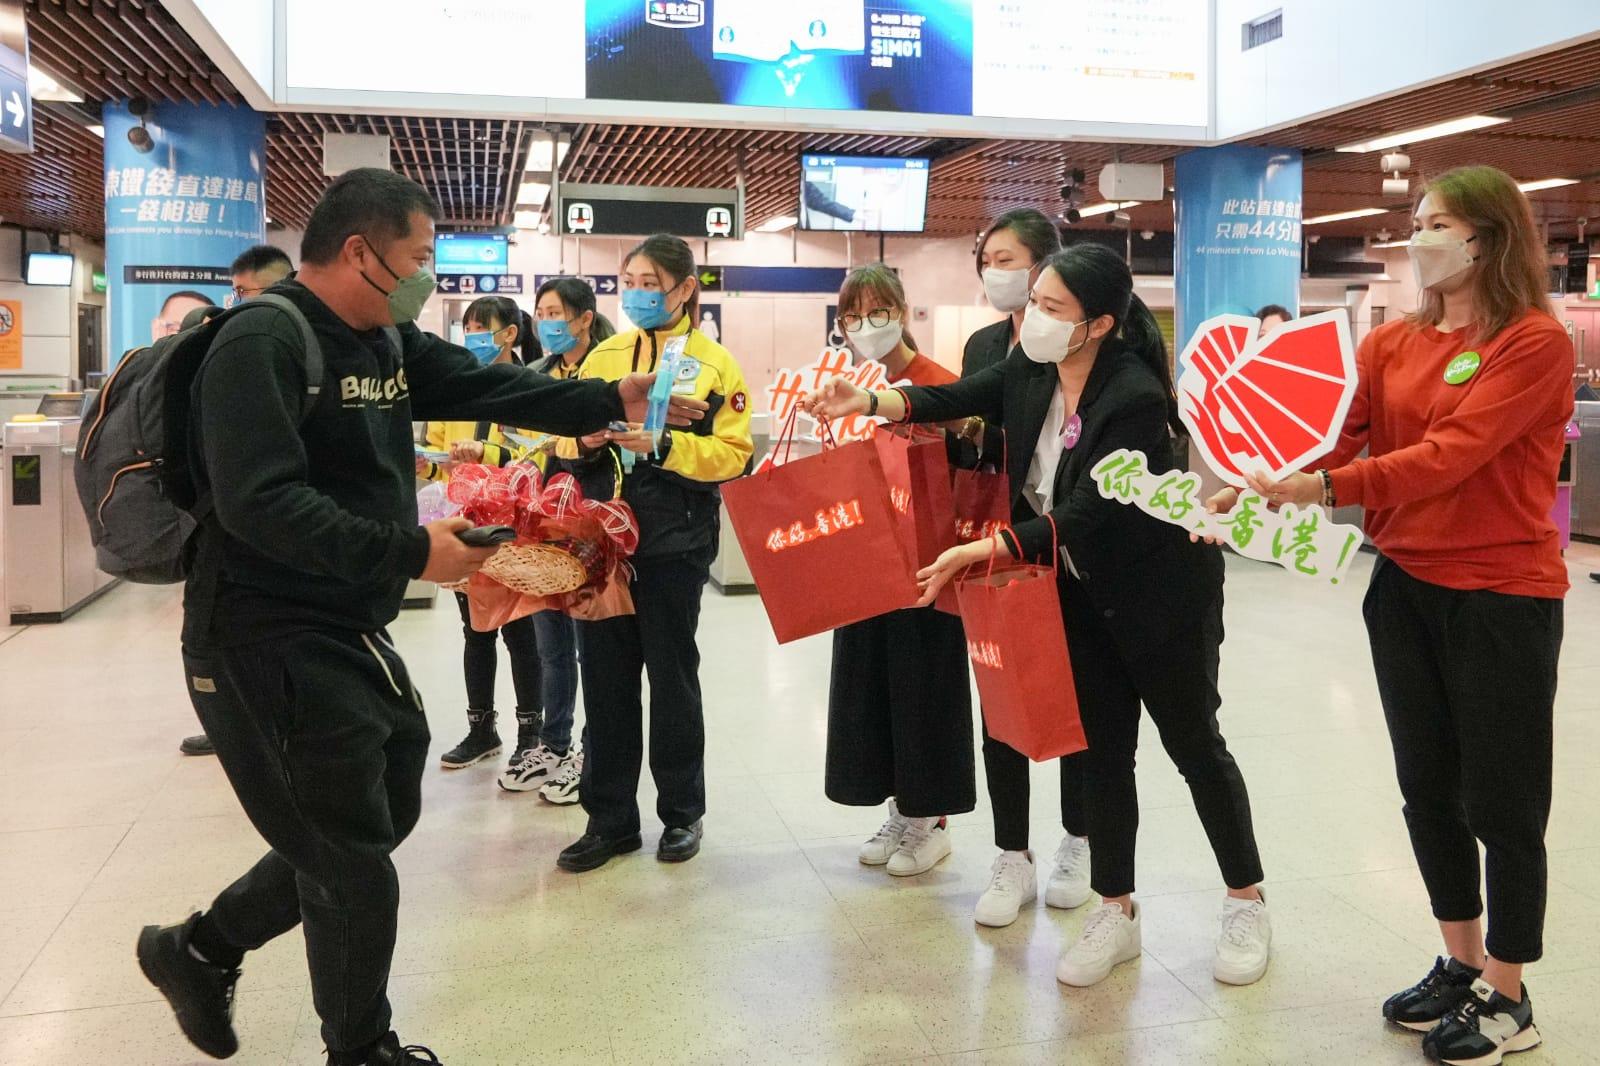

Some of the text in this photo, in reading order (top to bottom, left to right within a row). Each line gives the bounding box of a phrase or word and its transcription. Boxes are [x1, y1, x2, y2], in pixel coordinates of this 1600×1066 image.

[871, 38, 922, 57] SIM01
[1207, 246, 1240, 255] minutes
[1243, 246, 1264, 255] from
[1266, 247, 1276, 255] Lo
